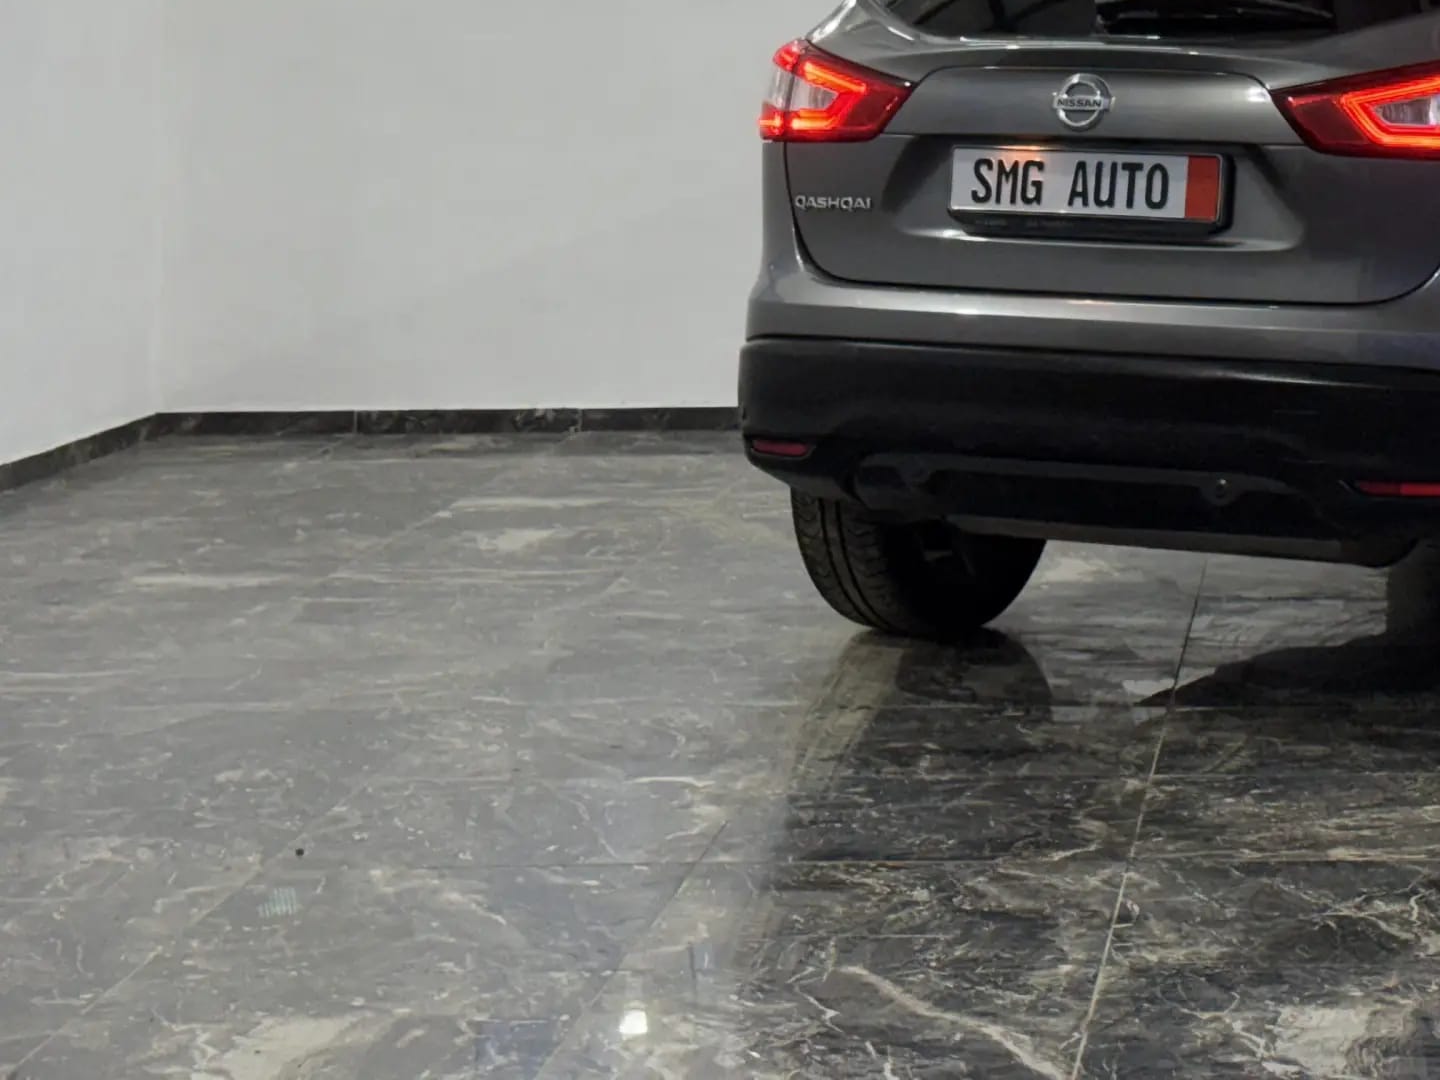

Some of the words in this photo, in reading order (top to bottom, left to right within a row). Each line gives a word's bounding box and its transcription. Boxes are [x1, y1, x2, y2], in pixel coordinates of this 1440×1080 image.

[1056, 97, 1102, 108] NISSAN
[971, 158, 1045, 206] SMG
[1068, 160, 1170, 210] AUTO
[795, 195, 871, 212] QASHQAI
